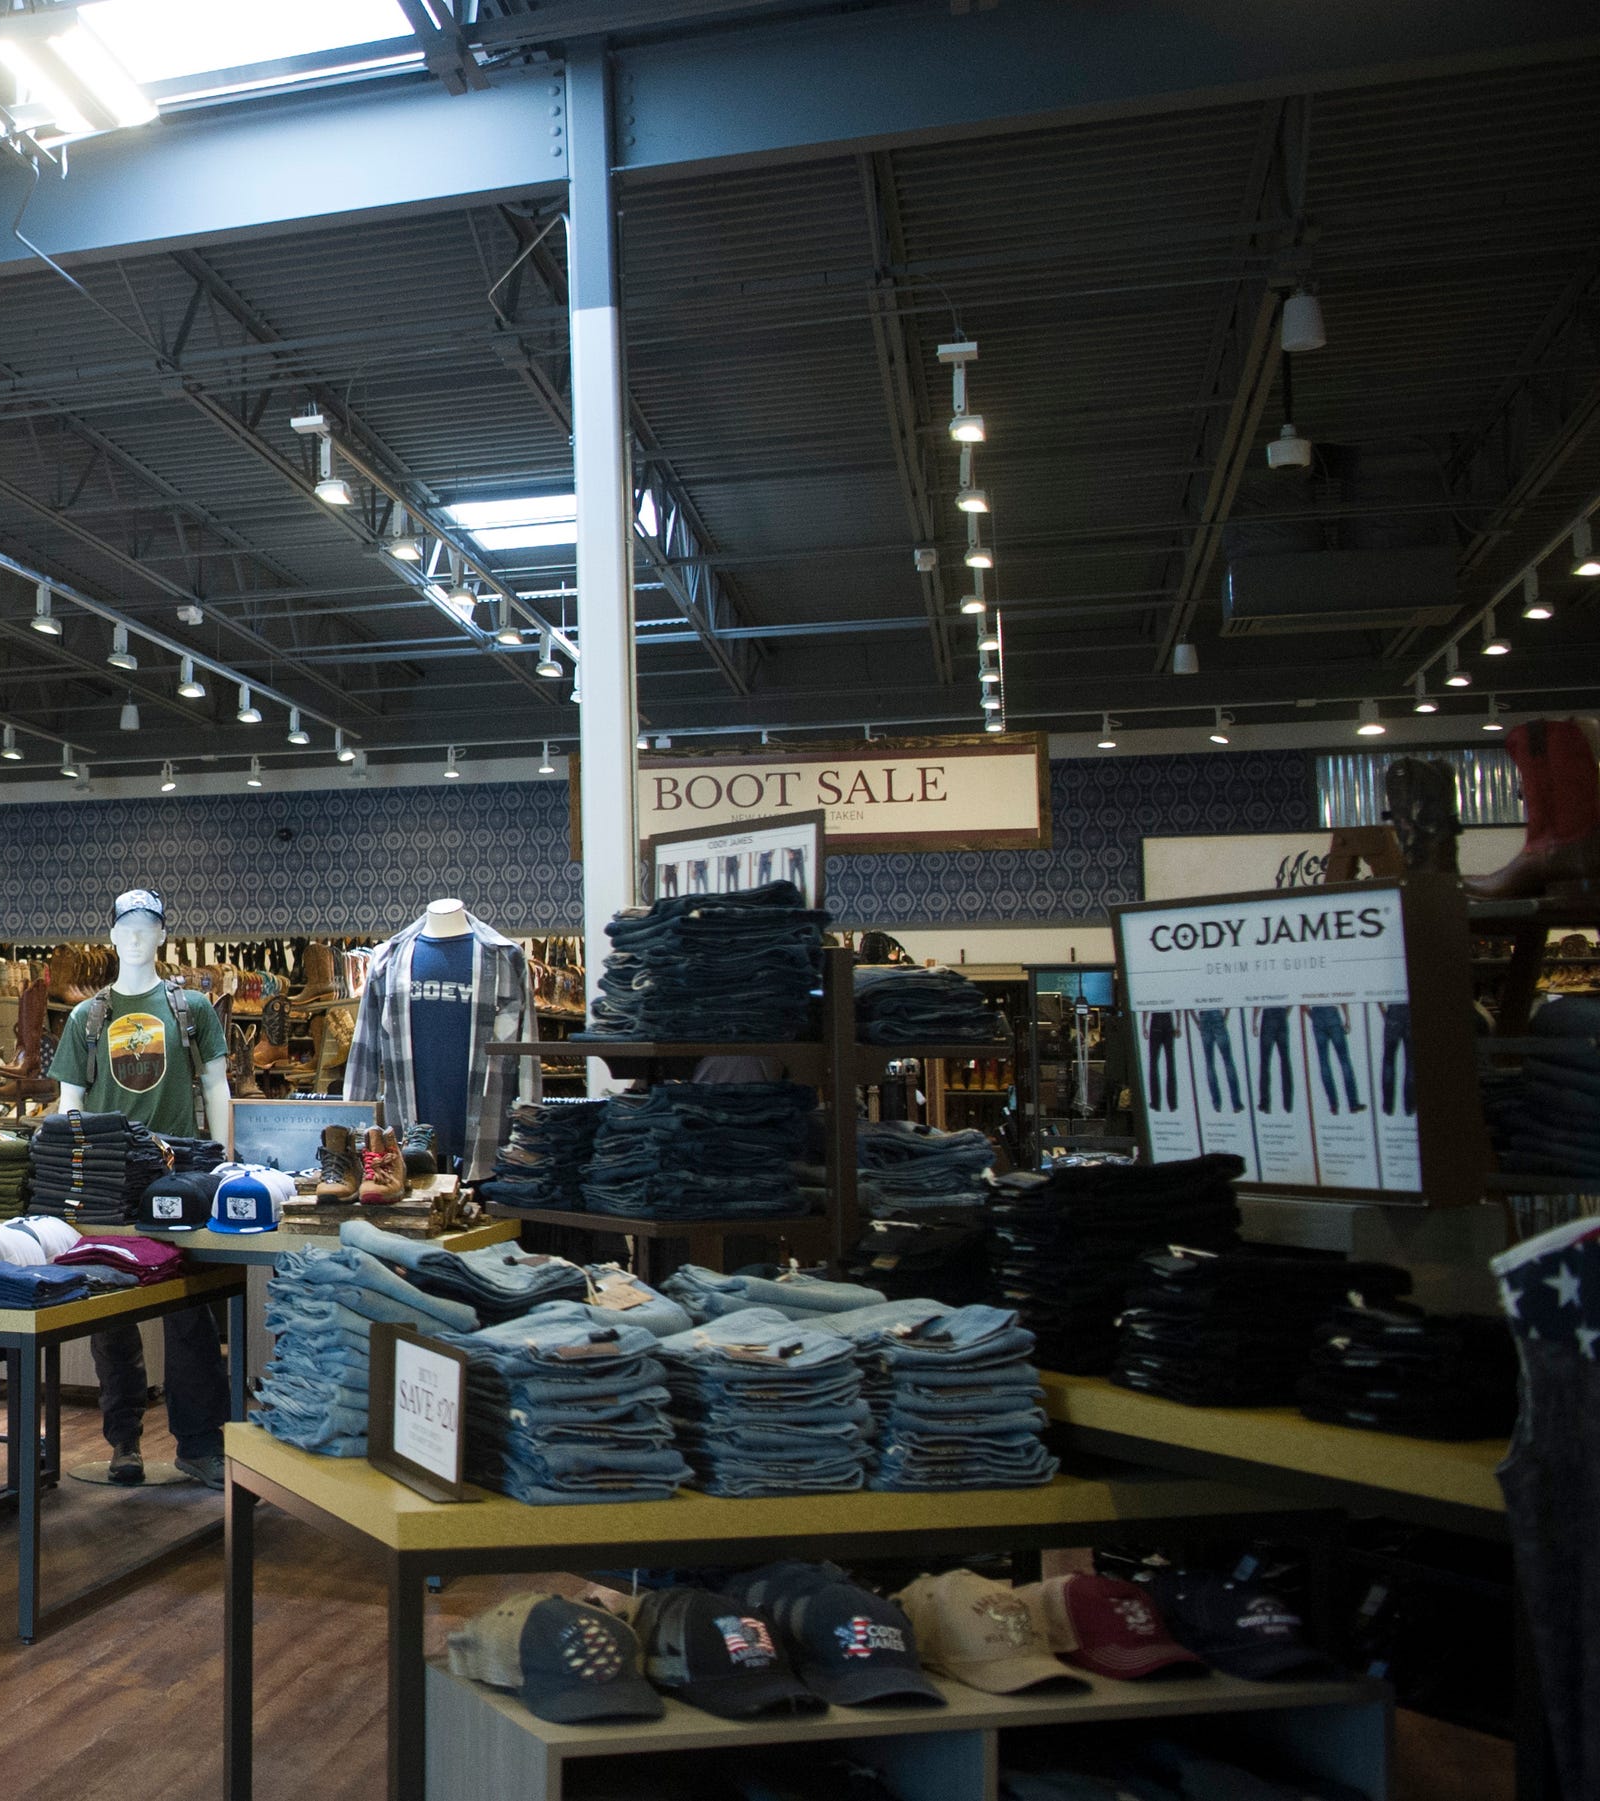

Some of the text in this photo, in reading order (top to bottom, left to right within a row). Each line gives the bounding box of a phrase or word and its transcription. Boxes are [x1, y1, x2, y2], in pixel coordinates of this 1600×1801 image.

[652, 766, 948, 811] BOOT SALE
[830, 810, 864, 821] TAKEN
[730, 836, 753, 846] JAMES
[1150, 908, 1386, 952] CODY JAMES
[1206, 957, 1327, 976] DENIM FIT GUIDE
[410, 980, 474, 1004] OOEY
[117, 1059, 161, 1081] HOOEY
[399, 1379, 434, 1423] SAVE
